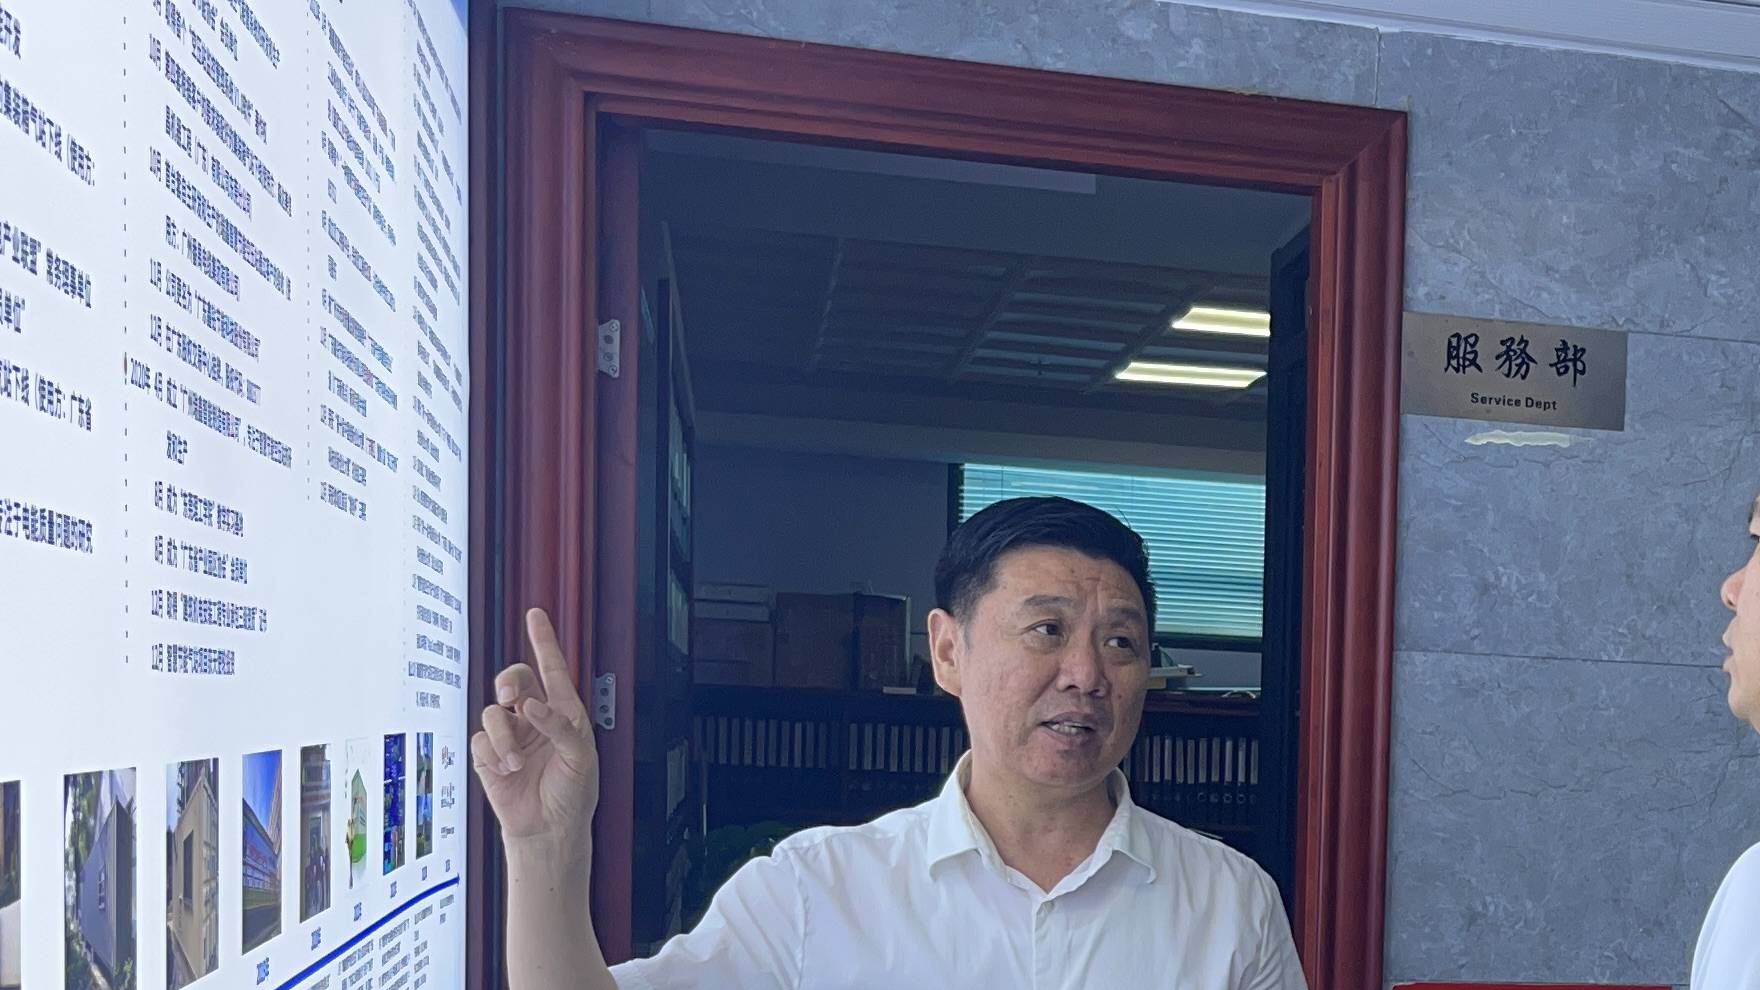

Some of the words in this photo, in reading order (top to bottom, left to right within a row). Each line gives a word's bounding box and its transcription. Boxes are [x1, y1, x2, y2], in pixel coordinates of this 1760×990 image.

[1444, 332, 1588, 388] 服務部
[1470, 393, 1521, 408] Service
[1525, 394, 1557, 412] Dept
